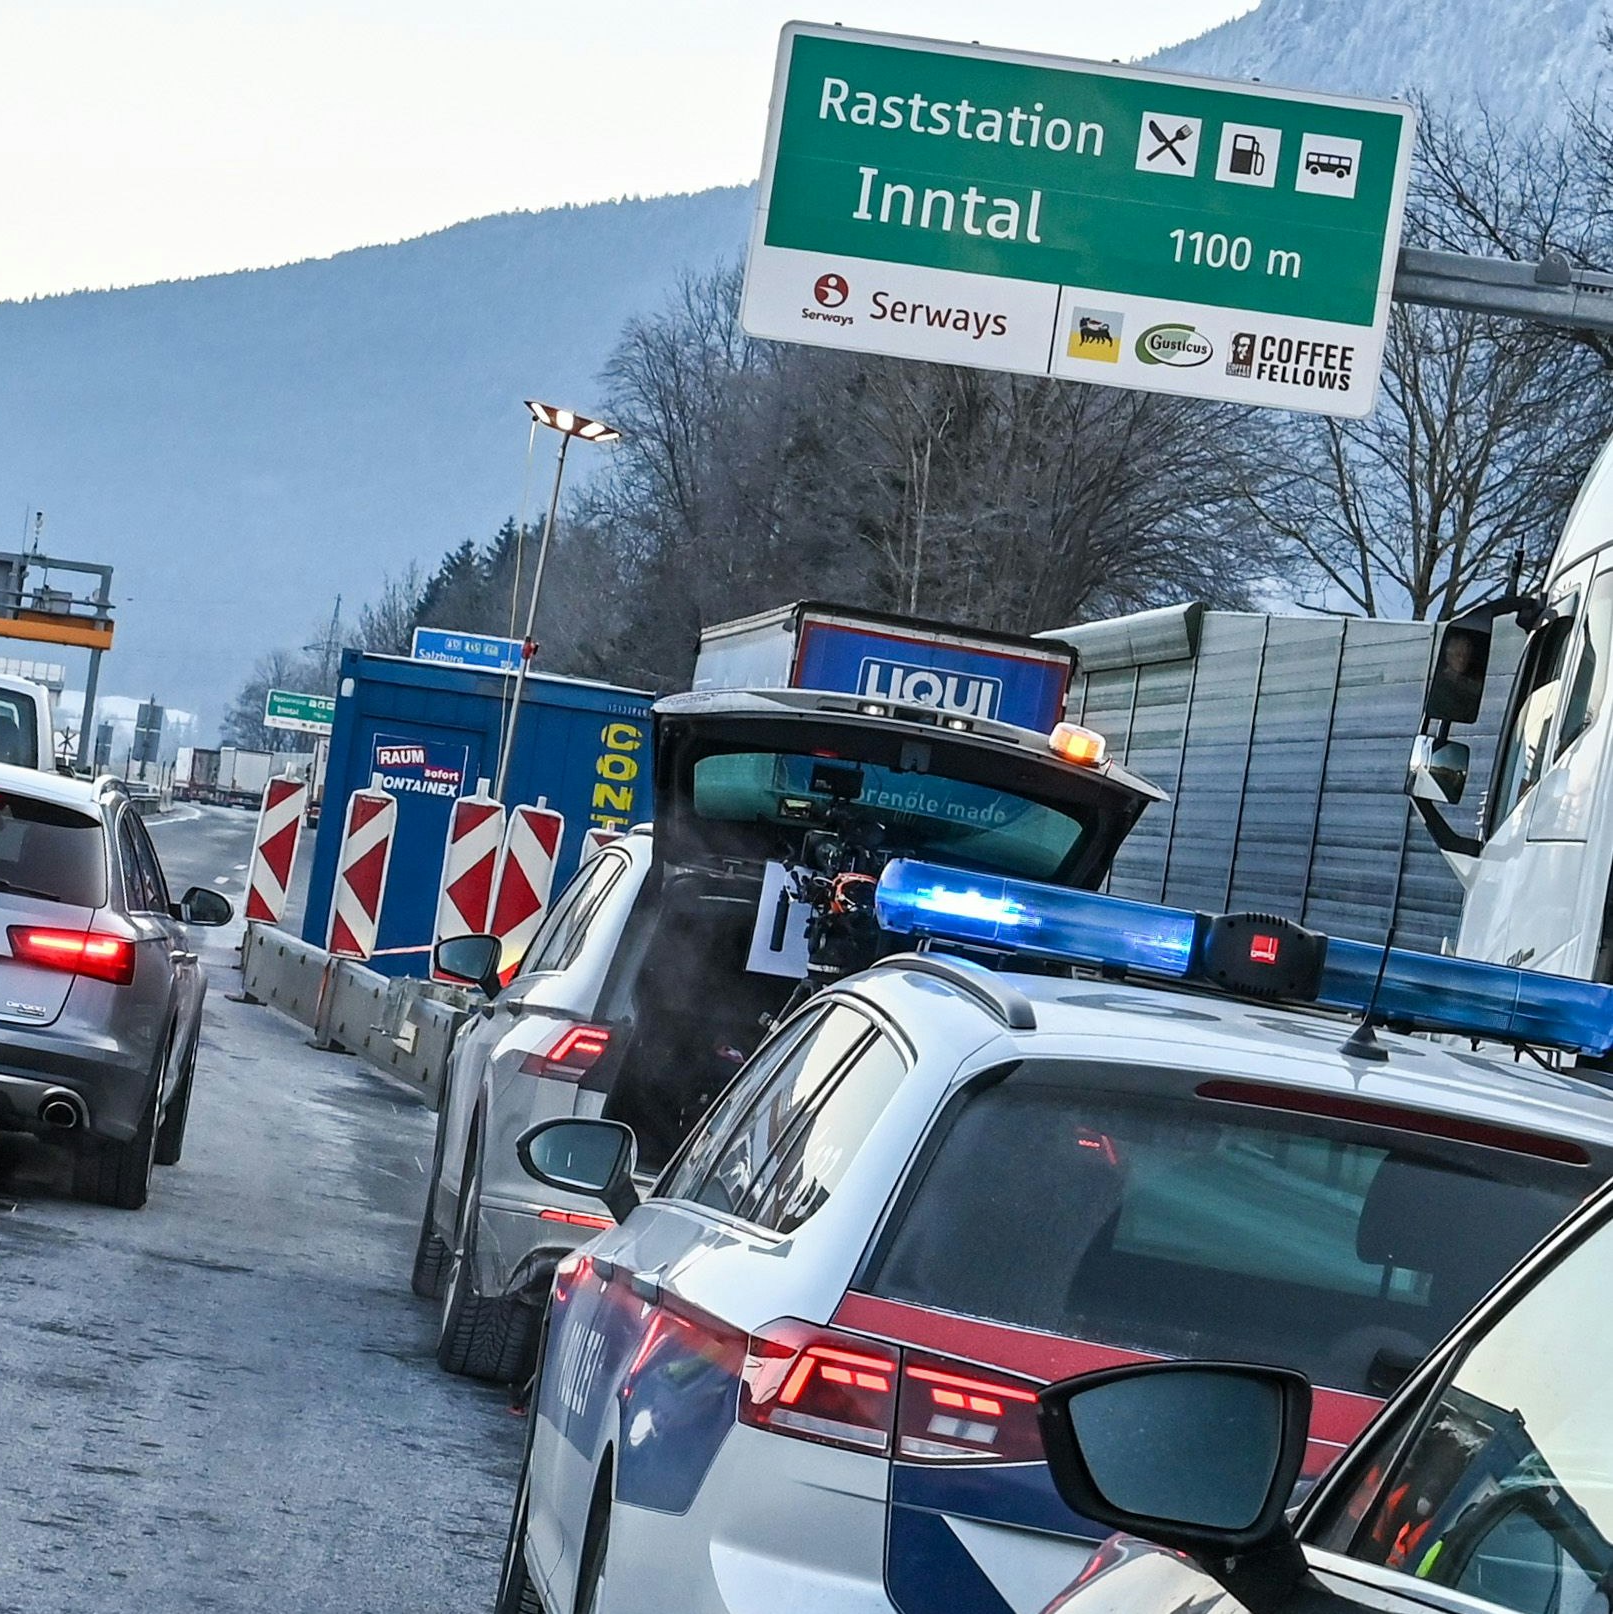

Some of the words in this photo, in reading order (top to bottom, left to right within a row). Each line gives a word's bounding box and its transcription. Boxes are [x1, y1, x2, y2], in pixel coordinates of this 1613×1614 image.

[818, 76, 1105, 157] Raststation
[852, 165, 1043, 244] Inntal
[1169, 228, 1252, 272] 1100
[1266, 248, 1302, 279] m
[801, 307, 854, 326] Serways
[870, 291, 1008, 340] Serways
[1149, 333, 1208, 355] Gusticus
[1260, 335, 1355, 372] COFFEE
[1256, 362, 1351, 392] FELLOWS
[865, 663, 994, 718] LIQUI
[380, 749, 425, 765] RAUM
[382, 775, 458, 798] ONTAINEX
[424, 768, 460, 782] sofort
[946, 793, 1007, 824] made
